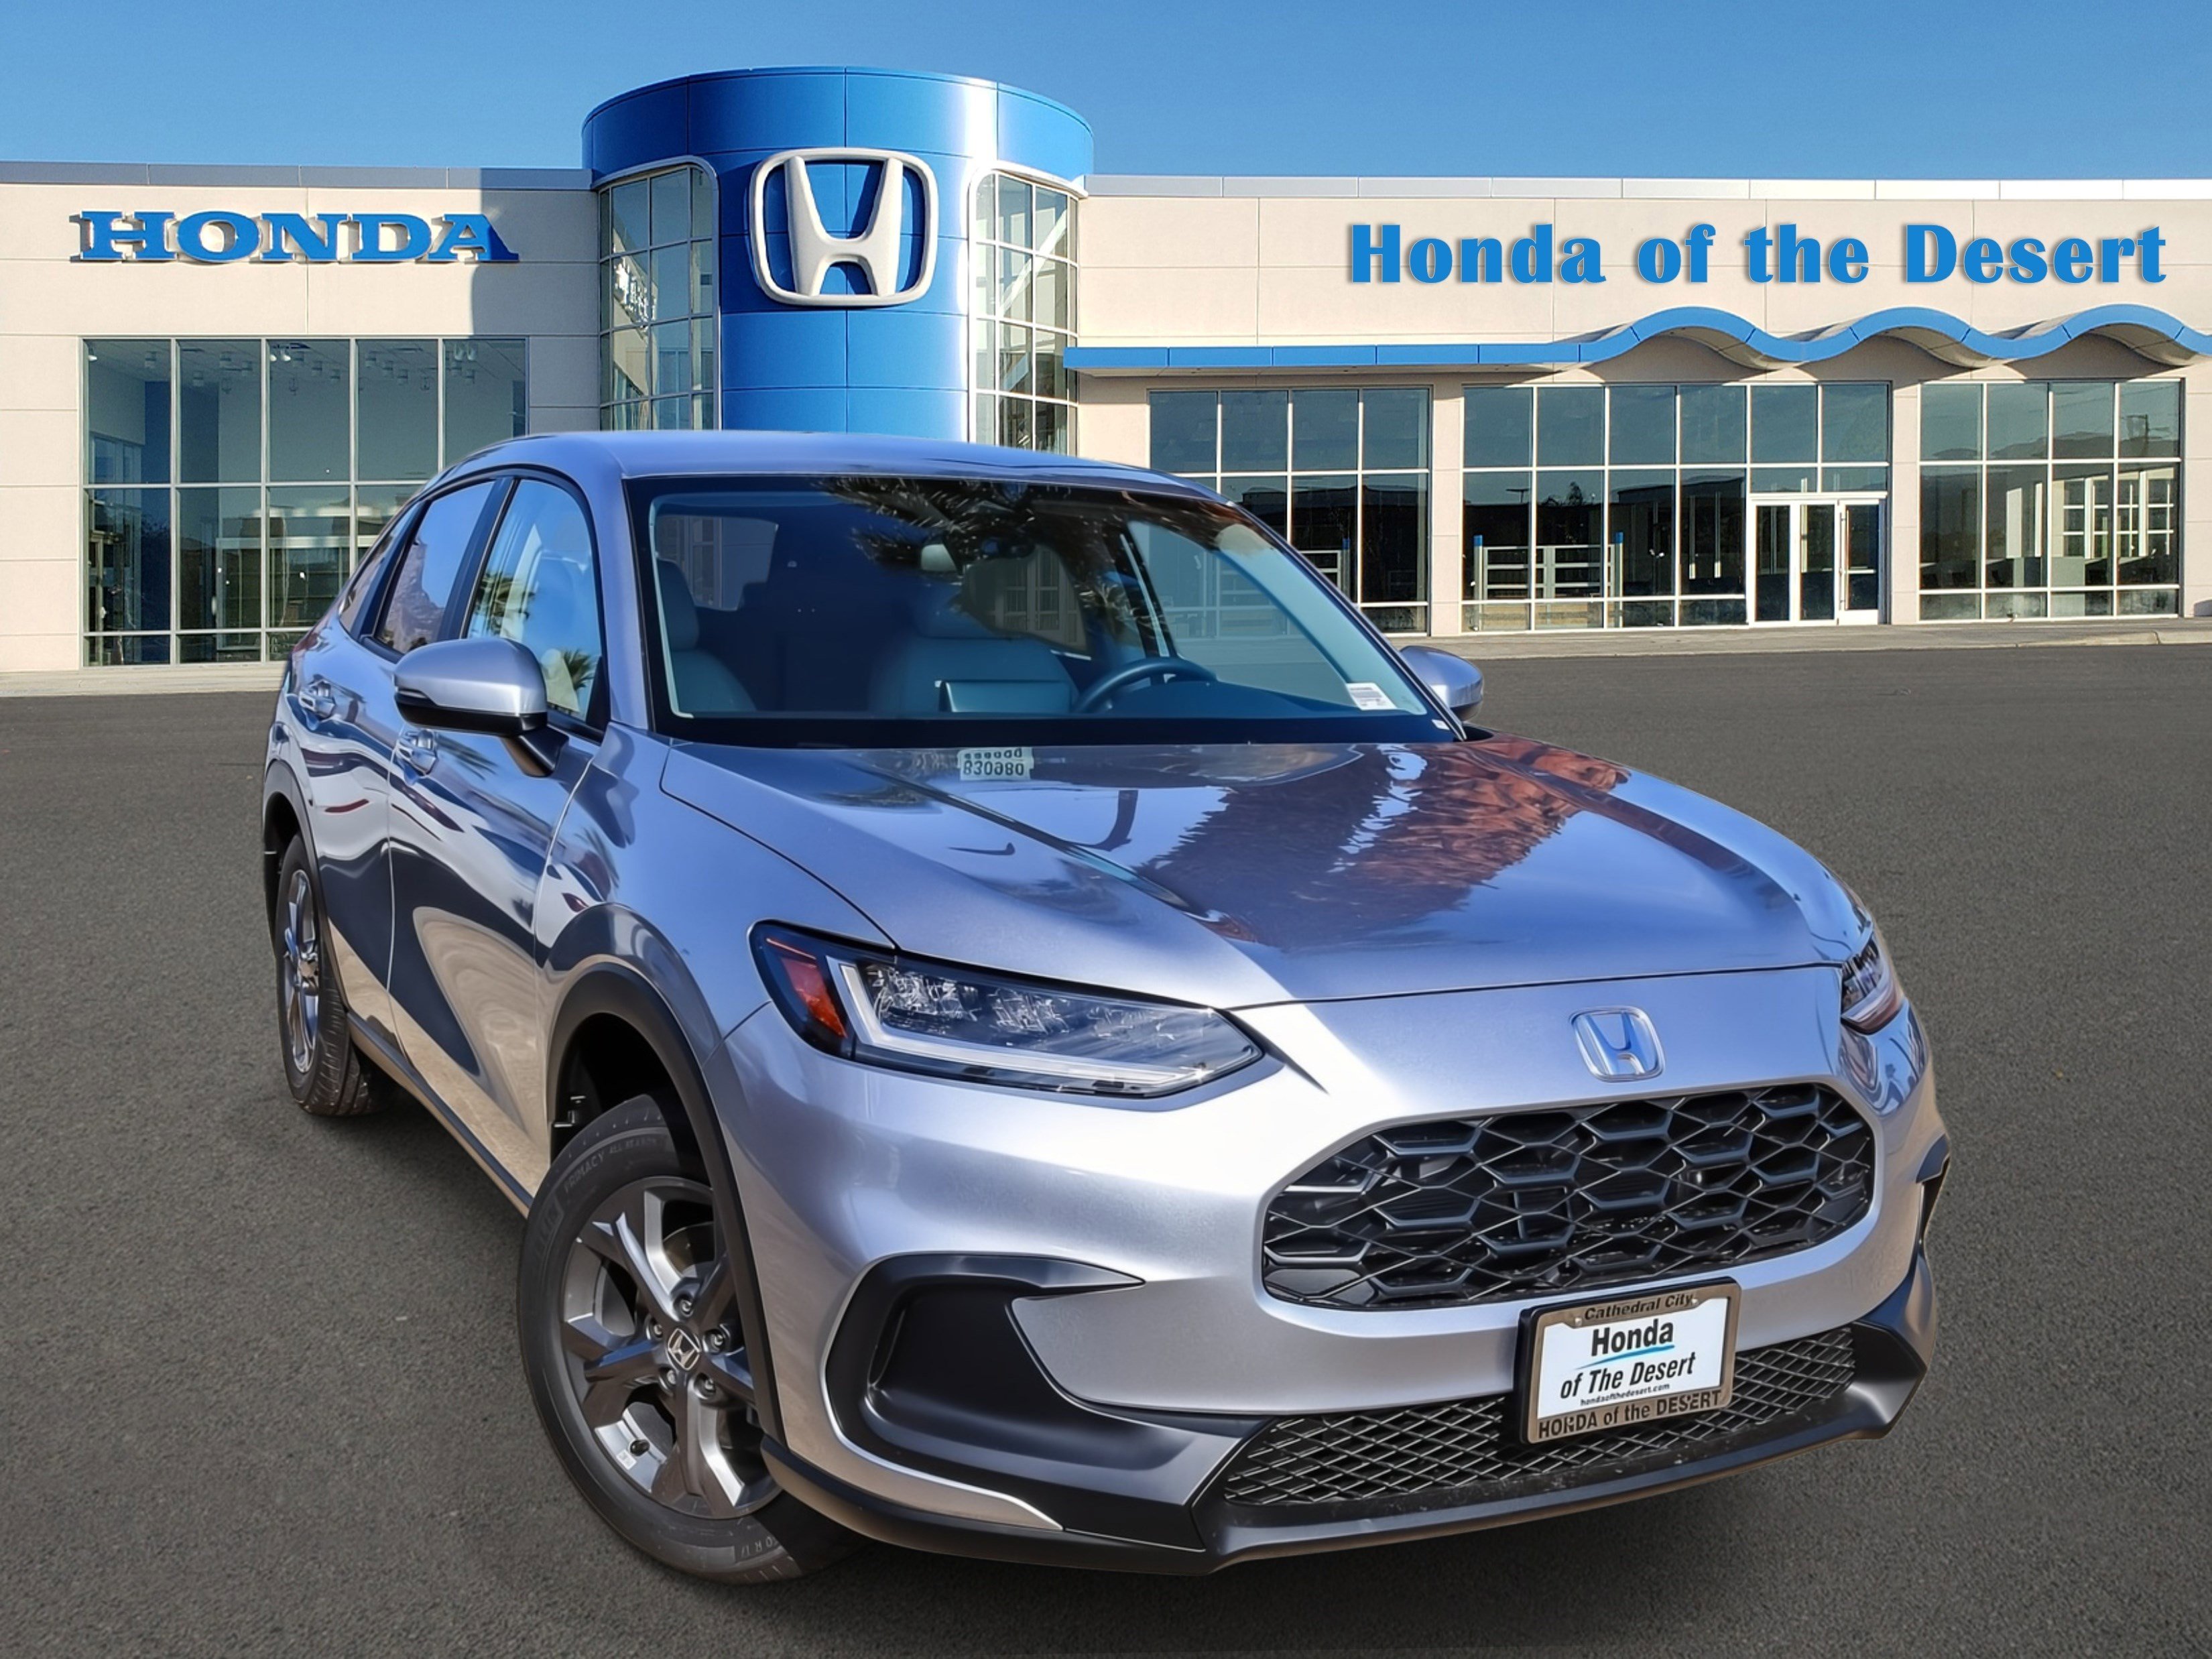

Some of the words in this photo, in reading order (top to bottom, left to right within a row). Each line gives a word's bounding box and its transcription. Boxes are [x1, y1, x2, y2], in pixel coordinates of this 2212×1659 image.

[70, 210, 519, 263] HONDA
[1352, 223, 1606, 284] Honda
[1638, 223, 1716, 284] of
[1744, 223, 1869, 284] the
[1906, 224, 2166, 284] Desert
[1585, 1298, 1661, 1320] Cathedral
[1591, 1318, 1674, 1357] Honda
[1560, 1372, 1583, 1399] of
[1588, 1368, 1623, 1394] The
[1629, 1351, 1696, 1386] Desert
[1580, 1384, 1670, 1406] hondaofthedesert.com
[1538, 1412, 1598, 1438] HONDA
[1603, 1408, 1619, 1425] of
[1624, 1404, 1650, 1422] the
[1656, 1390, 1722, 1416] DESERT
